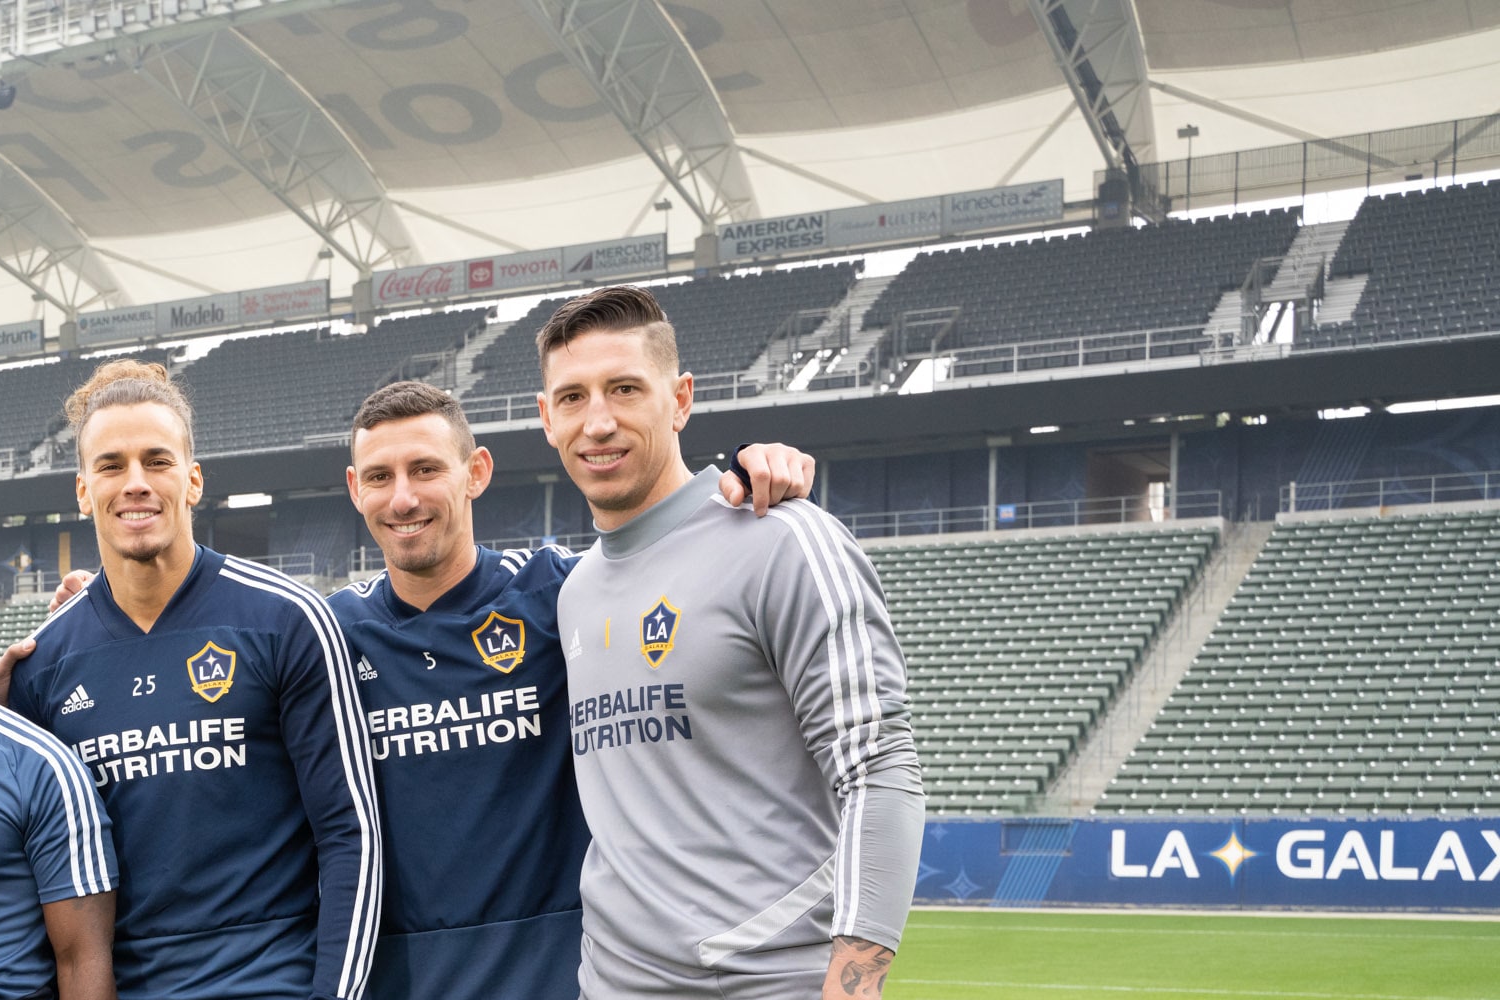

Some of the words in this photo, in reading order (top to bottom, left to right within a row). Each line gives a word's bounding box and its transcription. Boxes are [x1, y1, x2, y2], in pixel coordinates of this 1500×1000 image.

[952, 191, 1018, 213] kinecta
[722, 214, 823, 241] AMERICAN
[596, 240, 662, 259] MERCURY
[736, 231, 824, 255] EXPRESS
[500, 260, 559, 277] TOYOTA
[170, 303, 224, 329] Modelo
[646, 621, 668, 641] LA
[486, 632, 517, 654] LA
[199, 663, 226, 681] LA
[424, 652, 437, 670] 5
[132, 675, 157, 697] 25
[61, 699, 95, 715] adidas
[368, 686, 540, 735] ERBALIFE
[371, 713, 542, 761] UTRITION
[574, 714, 693, 757] UTRITION
[95, 744, 247, 788] UTRITION
[1110, 829, 1200, 879] LA
